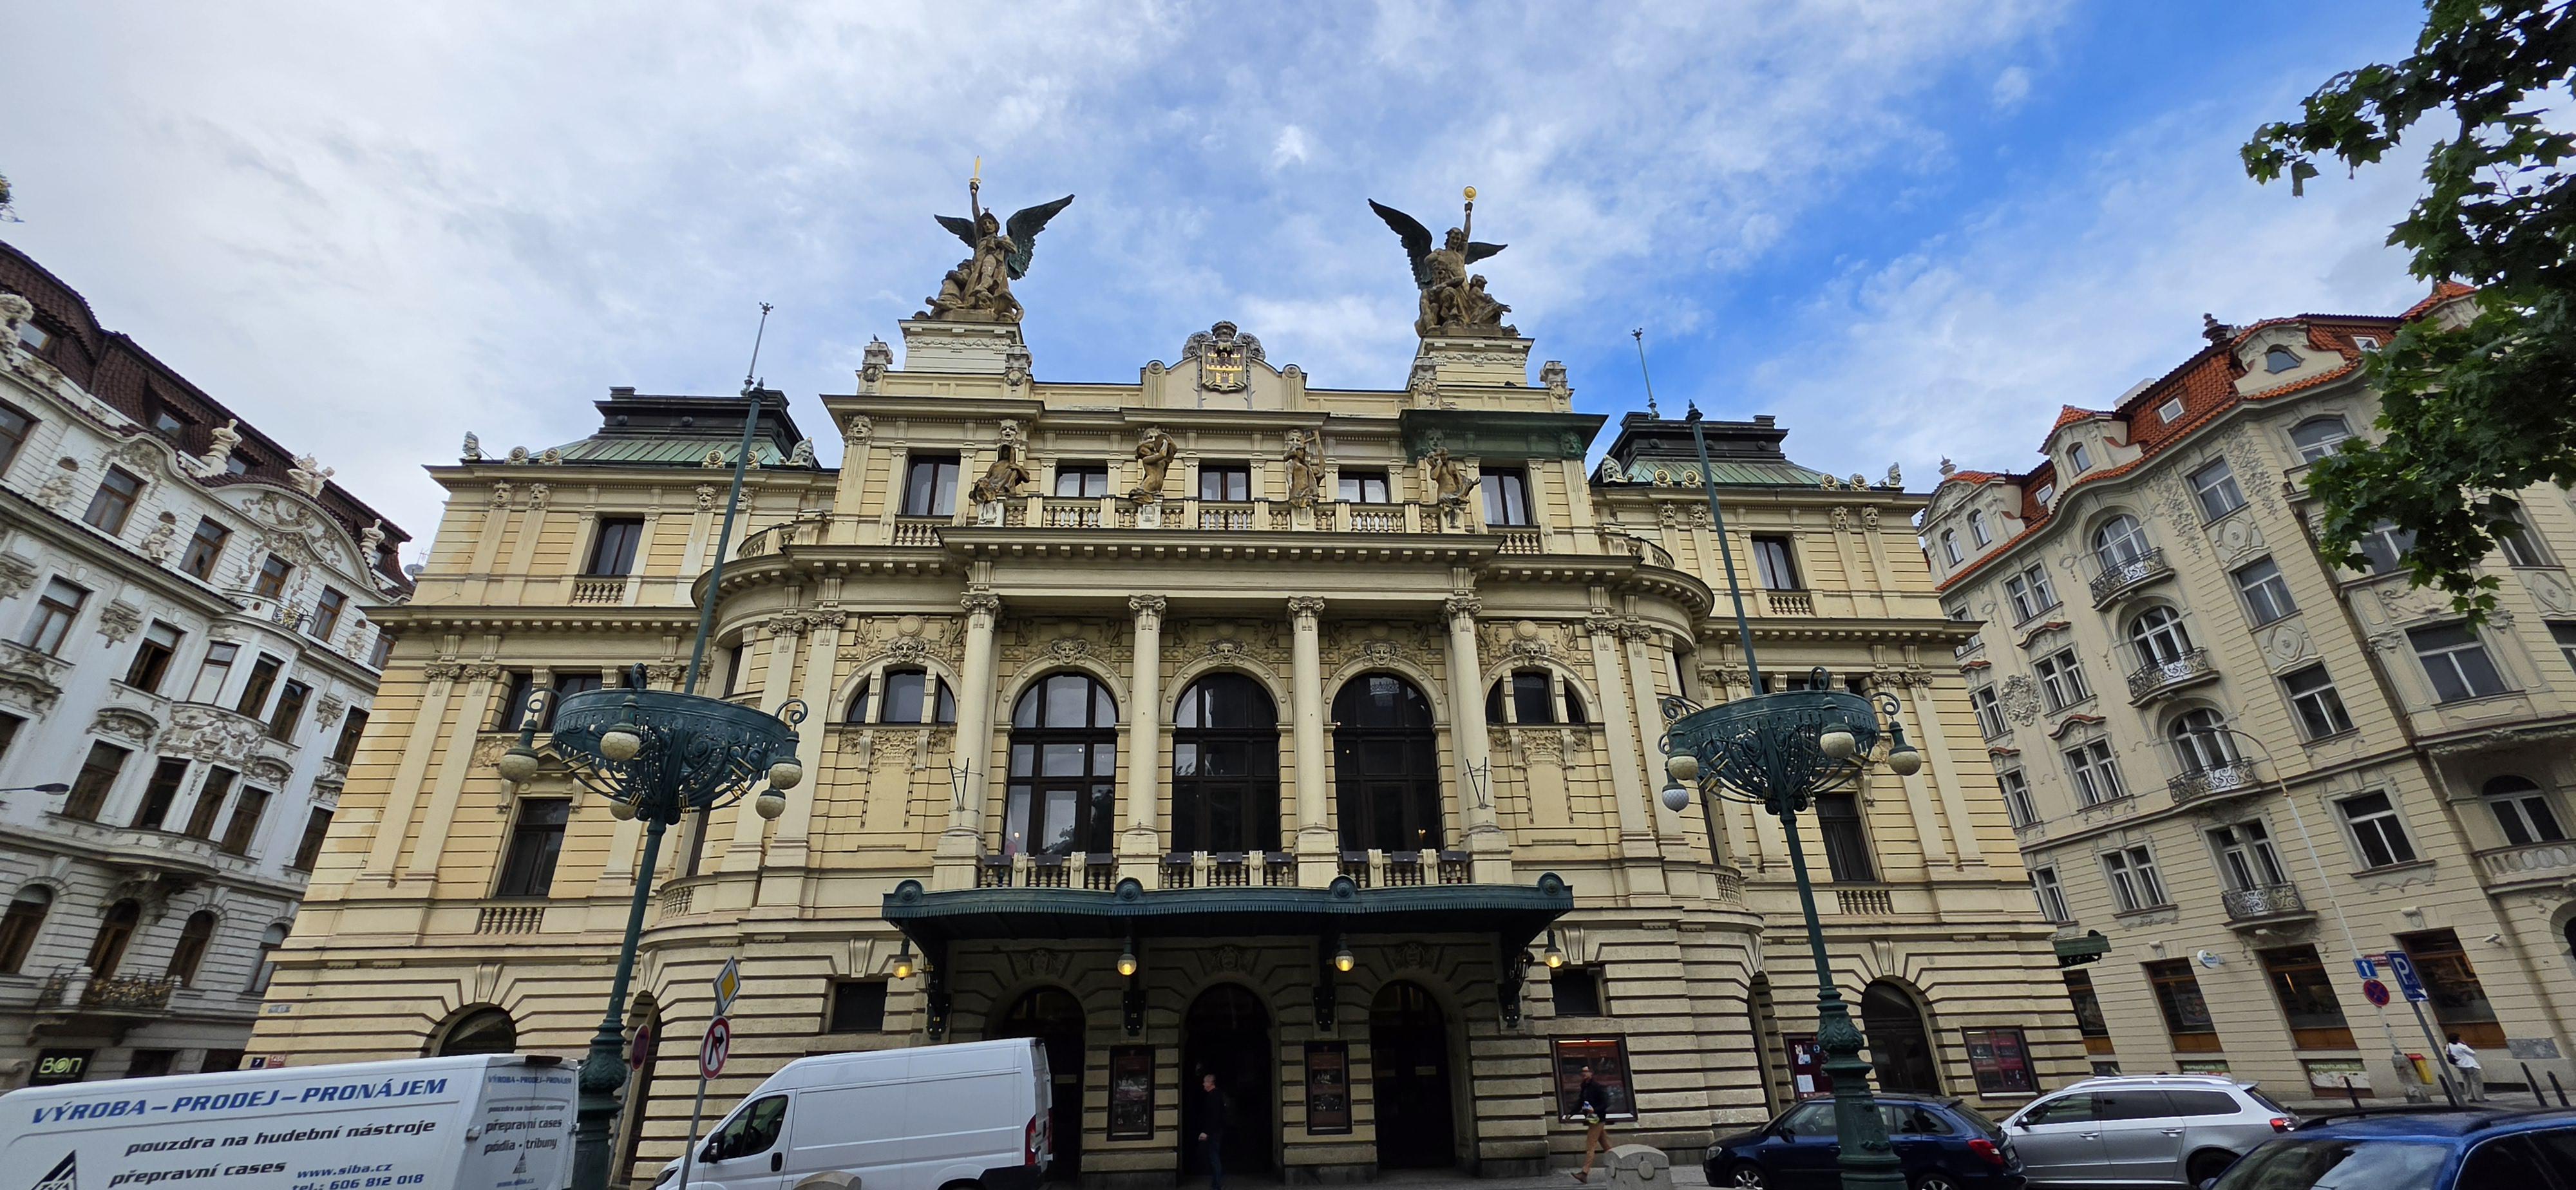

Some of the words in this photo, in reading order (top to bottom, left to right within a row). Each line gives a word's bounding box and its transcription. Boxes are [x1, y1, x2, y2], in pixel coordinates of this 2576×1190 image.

[2393, 958, 2409, 985] P
[32, 1099, 147, 1124] VÝROBA
[171, 1090, 279, 1113] PRODEJ
[299, 1079, 448, 1103] PRONÁJEM
[485, 1117, 537, 1135] přepravní
[538, 1119, 562, 1128] cases
[124, 1136, 214, 1157] pouzdra
[220, 1134, 248, 1148] na
[254, 1125, 344, 1145] hudební
[346, 1120, 437, 1137] nástroje
[484, 1139, 515, 1156] pódia
[526, 1138, 558, 1149] tribuny
[108, 1163, 222, 1189] přepravní
[223, 1162, 287, 1176] cases
[297, 1164, 393, 1178] www.siba.cz
[330, 1178, 361, 1190] 606
[365, 1176, 392, 1187] 812
[397, 1174, 424, 1185] 018
